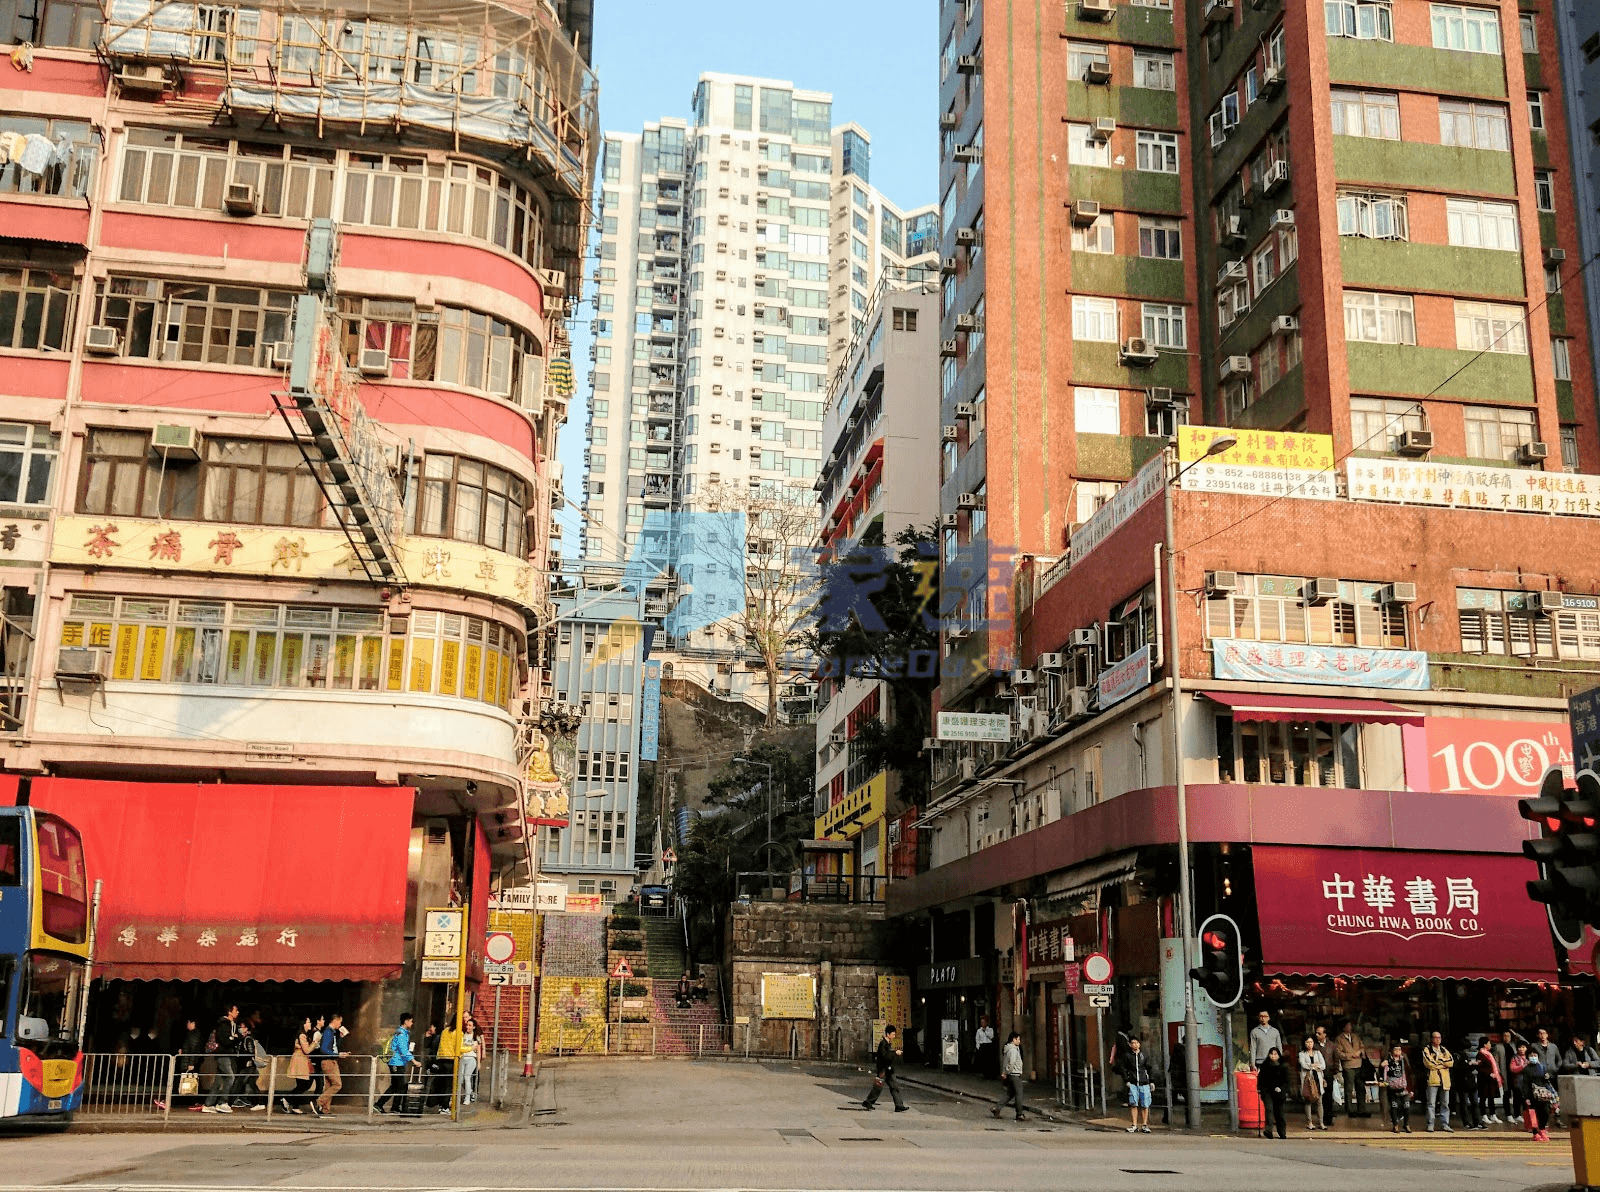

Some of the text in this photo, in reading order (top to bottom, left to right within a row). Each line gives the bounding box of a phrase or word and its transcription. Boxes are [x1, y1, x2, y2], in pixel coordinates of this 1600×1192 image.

[1205, 479, 1256, 491] 23951488
[1576, 599, 1596, 608] 9100
[1575, 713, 1598, 736] 香港
[500, 889, 531, 903] FAMILY
[1321, 872, 1480, 916] 中華書局
[1327, 914, 1484, 932] CHUNG HWA BOOK CO.
[448, 934, 455, 942] 7
[447, 946, 454, 954] 7
[930, 966, 956, 983] PLATO
